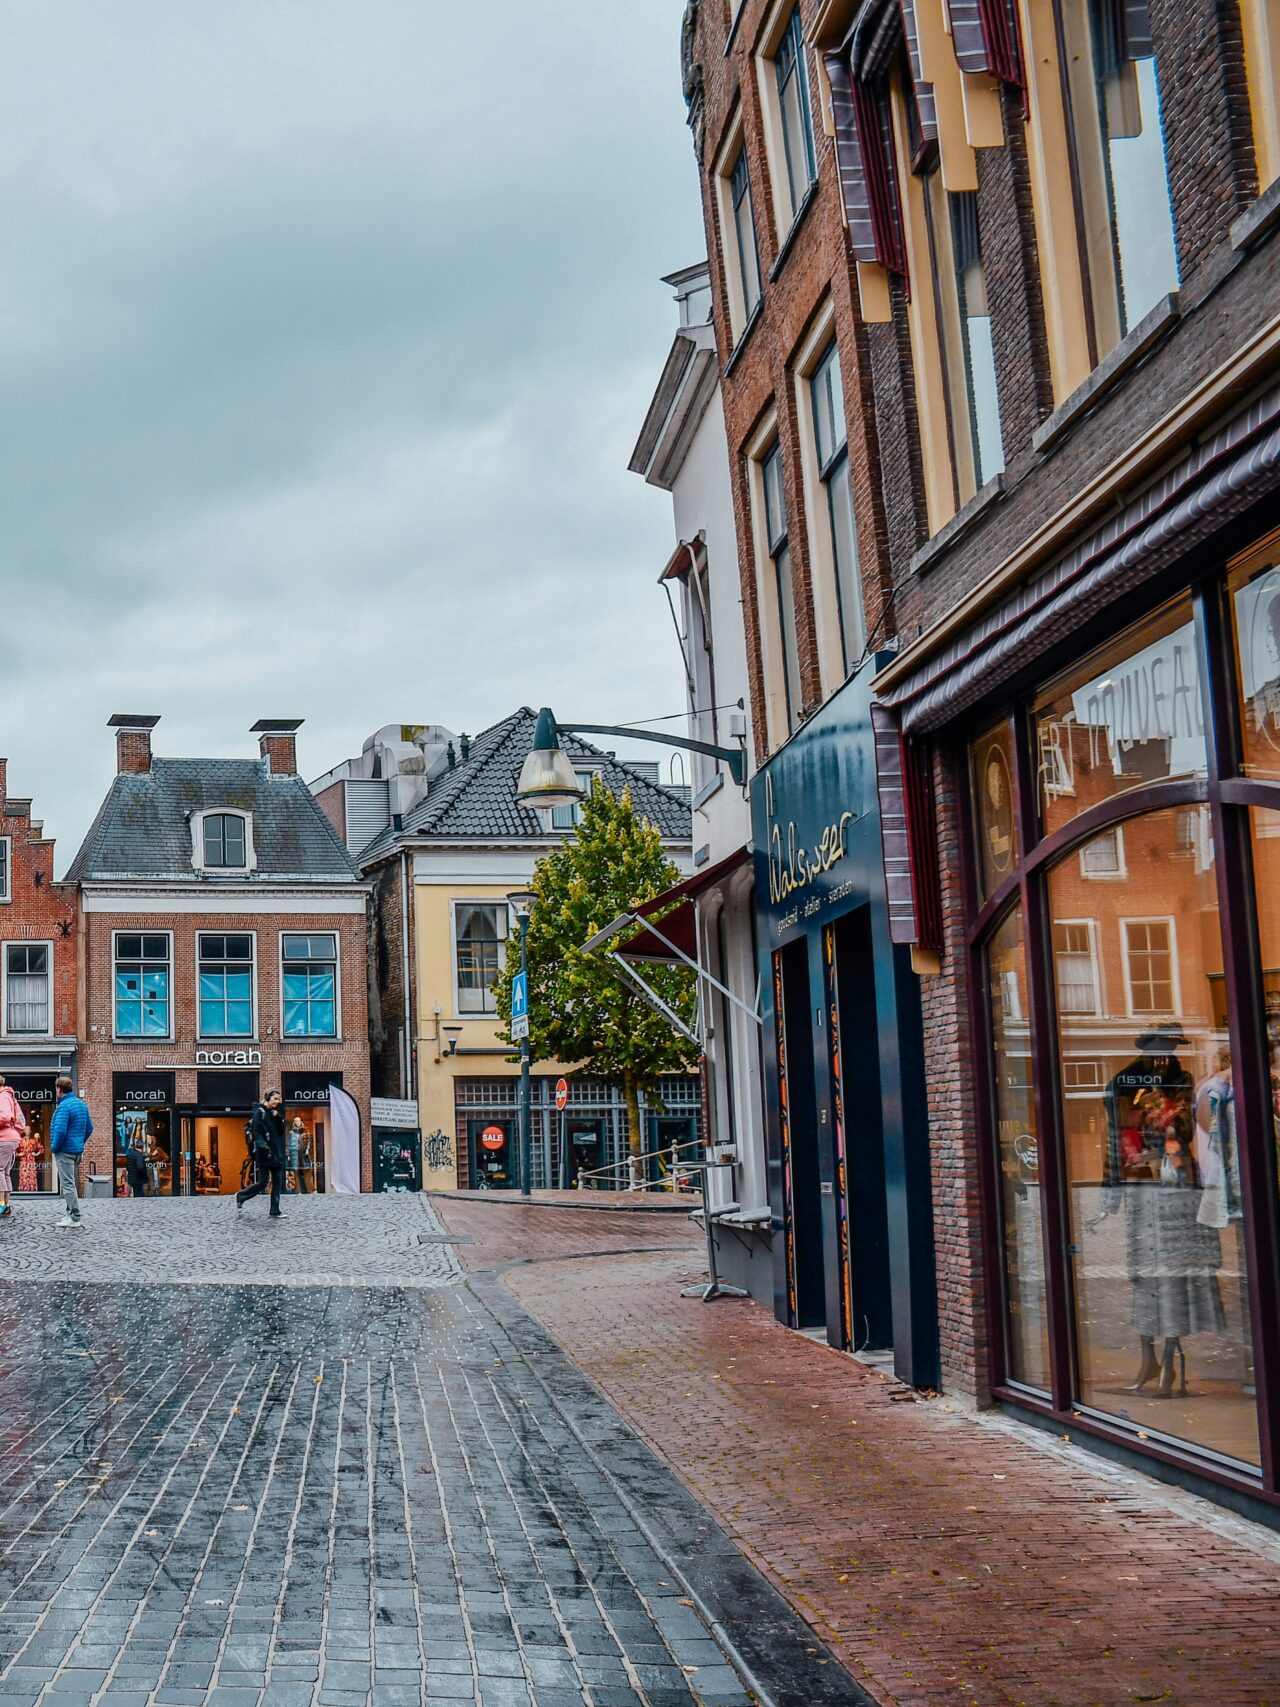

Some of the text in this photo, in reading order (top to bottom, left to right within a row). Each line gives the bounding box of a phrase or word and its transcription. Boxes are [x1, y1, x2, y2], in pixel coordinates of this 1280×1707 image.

[765, 770, 853, 905] Walsweer
[195, 1047, 262, 1065] norah
[12, 1089, 53, 1099] norah
[126, 1089, 166, 1100] norah
[482, 1134, 504, 1142] SALE
